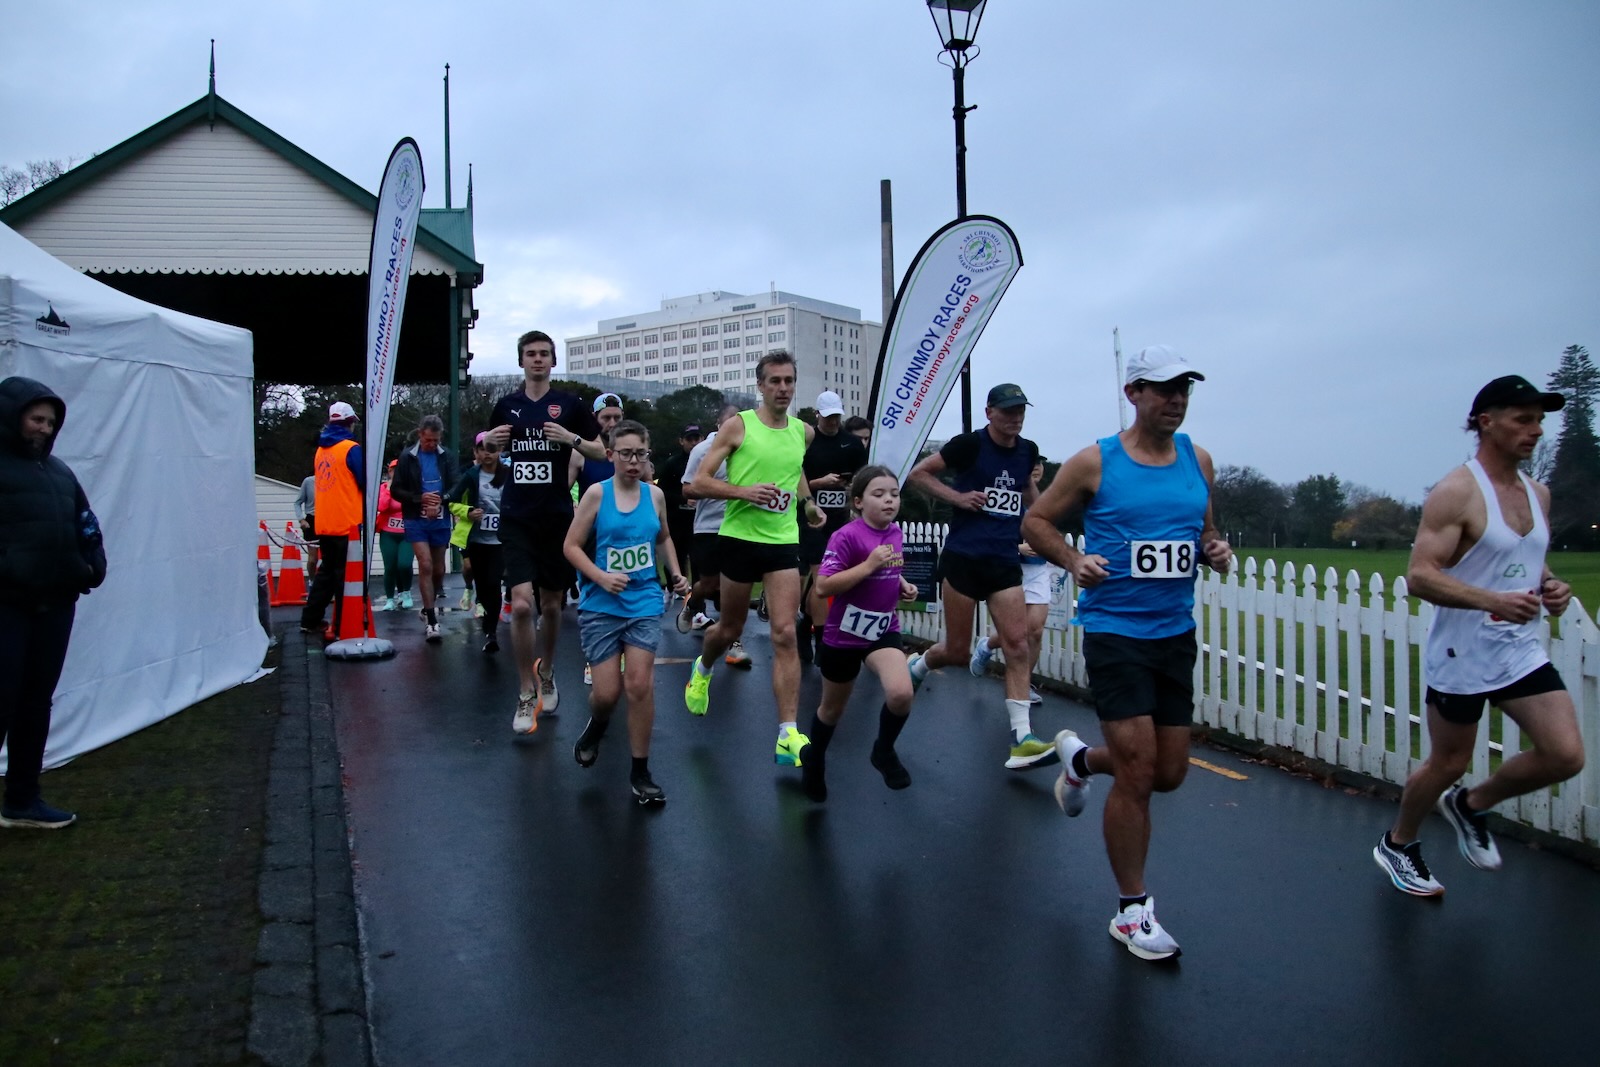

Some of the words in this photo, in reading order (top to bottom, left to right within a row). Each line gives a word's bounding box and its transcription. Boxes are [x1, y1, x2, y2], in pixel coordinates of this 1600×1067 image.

[385, 216, 403, 283] RACES
[974, 230, 1001, 246] CHINMOY
[958, 254, 984, 273] MARATHON
[38, 324, 53, 333] GREAT
[881, 401, 904, 429] SRI
[896, 327, 941, 401] CHINMOY
[932, 273, 972, 329] RACES
[904, 294, 980, 425] nz.srichinmoyraces.org
[514, 463, 549, 481] 633
[818, 491, 845, 506] 623
[985, 490, 1019, 512] 628
[610, 545, 649, 570] 206
[1136, 543, 1191, 573] 618
[849, 611, 890, 638] 179
